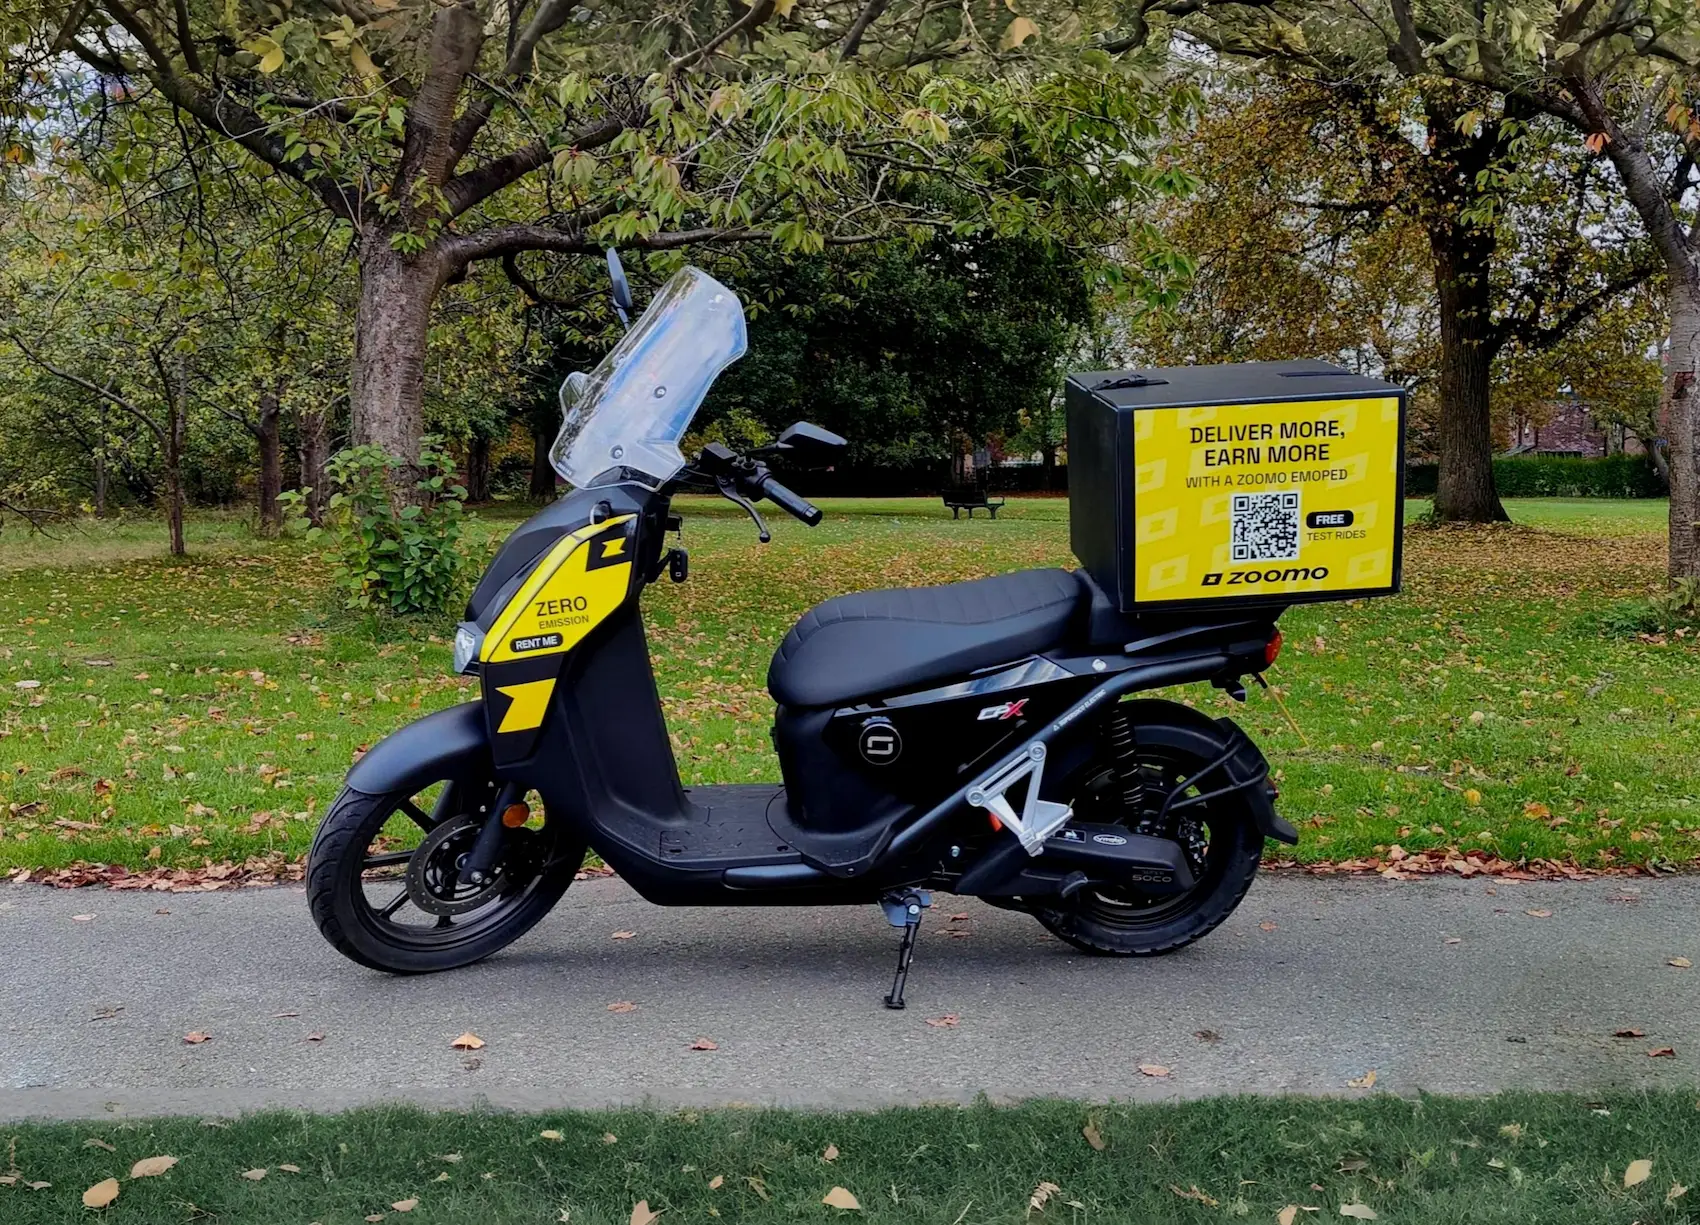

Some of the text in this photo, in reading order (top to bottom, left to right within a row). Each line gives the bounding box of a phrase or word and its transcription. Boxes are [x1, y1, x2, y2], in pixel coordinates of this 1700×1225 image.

[1189, 420, 1345, 444] DELIVER MORE,
[1204, 443, 1330, 467] EARN MORE
[1185, 468, 1348, 488] WITH A ZOOMO EMOPED
[1315, 514, 1345, 525] FREE
[1306, 529, 1366, 542] TEST RIDES
[1226, 566, 1329, 585] zoomo
[535, 595, 588, 617] ZERO
[538, 614, 590, 630] EMISSION
[515, 635, 558, 651] RENT ME
[1132, 874, 1172, 883] SOCO
